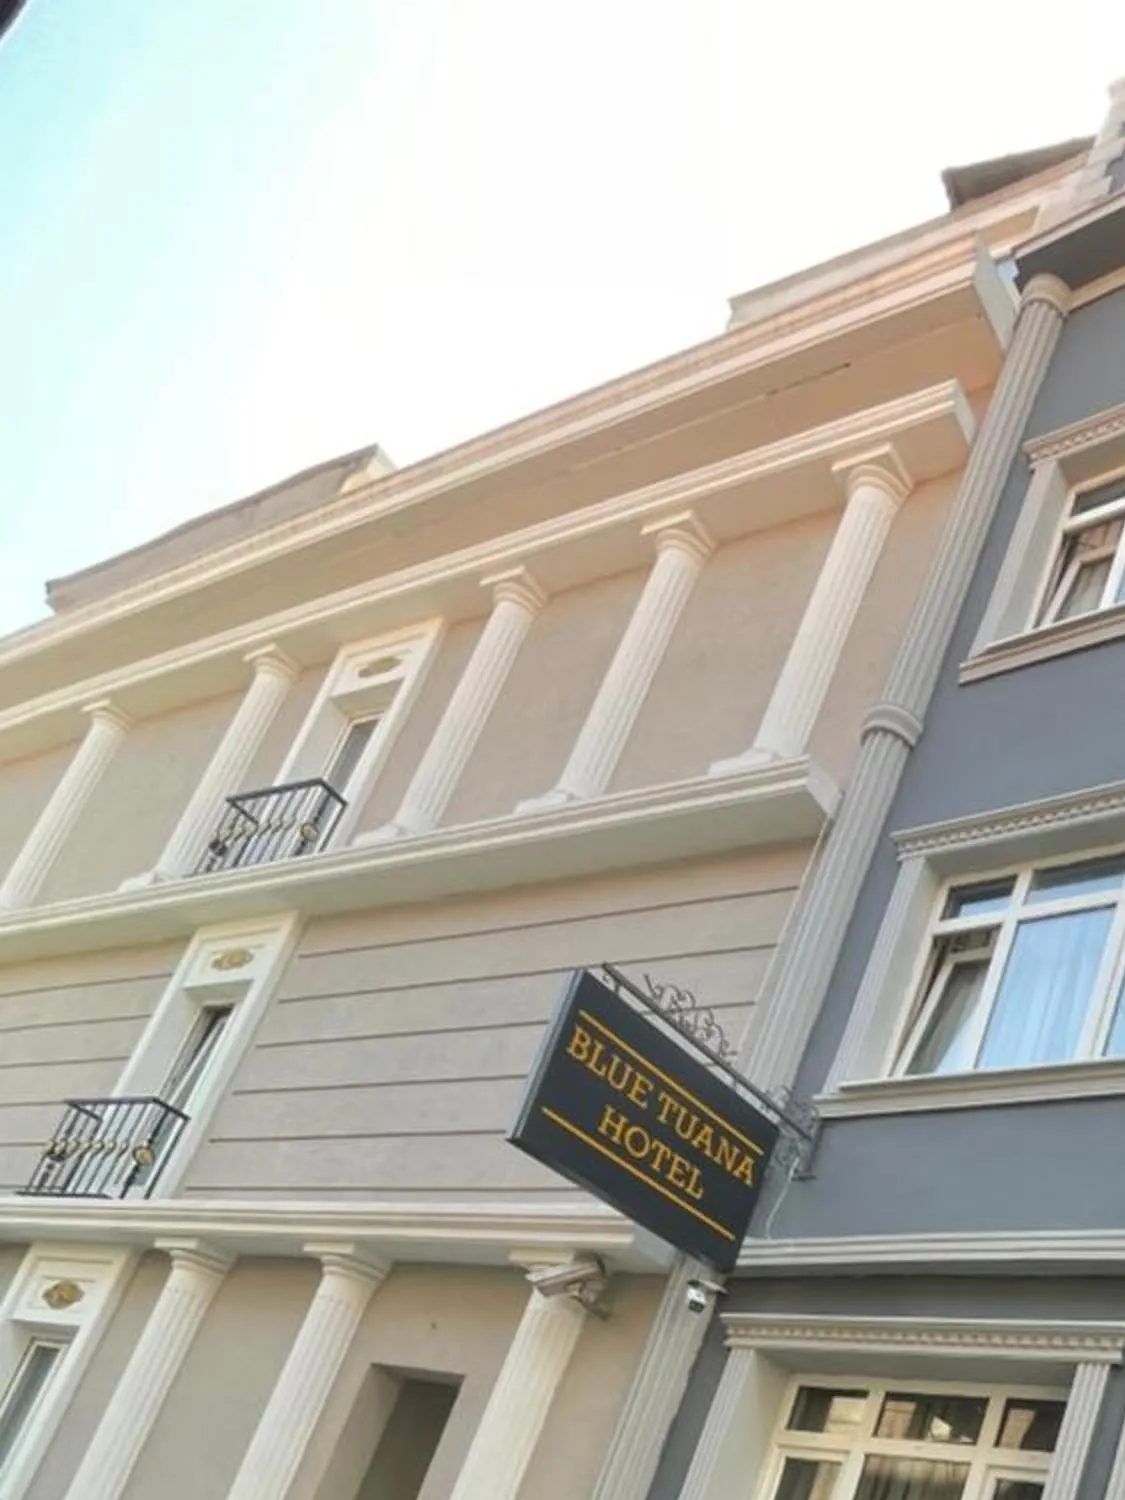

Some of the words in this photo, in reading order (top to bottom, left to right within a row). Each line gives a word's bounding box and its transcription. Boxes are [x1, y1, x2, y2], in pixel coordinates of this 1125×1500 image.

[566, 1026, 654, 1109] BLUE
[656, 1091, 754, 1188] TUANA
[598, 1104, 704, 1200] HOTEL
